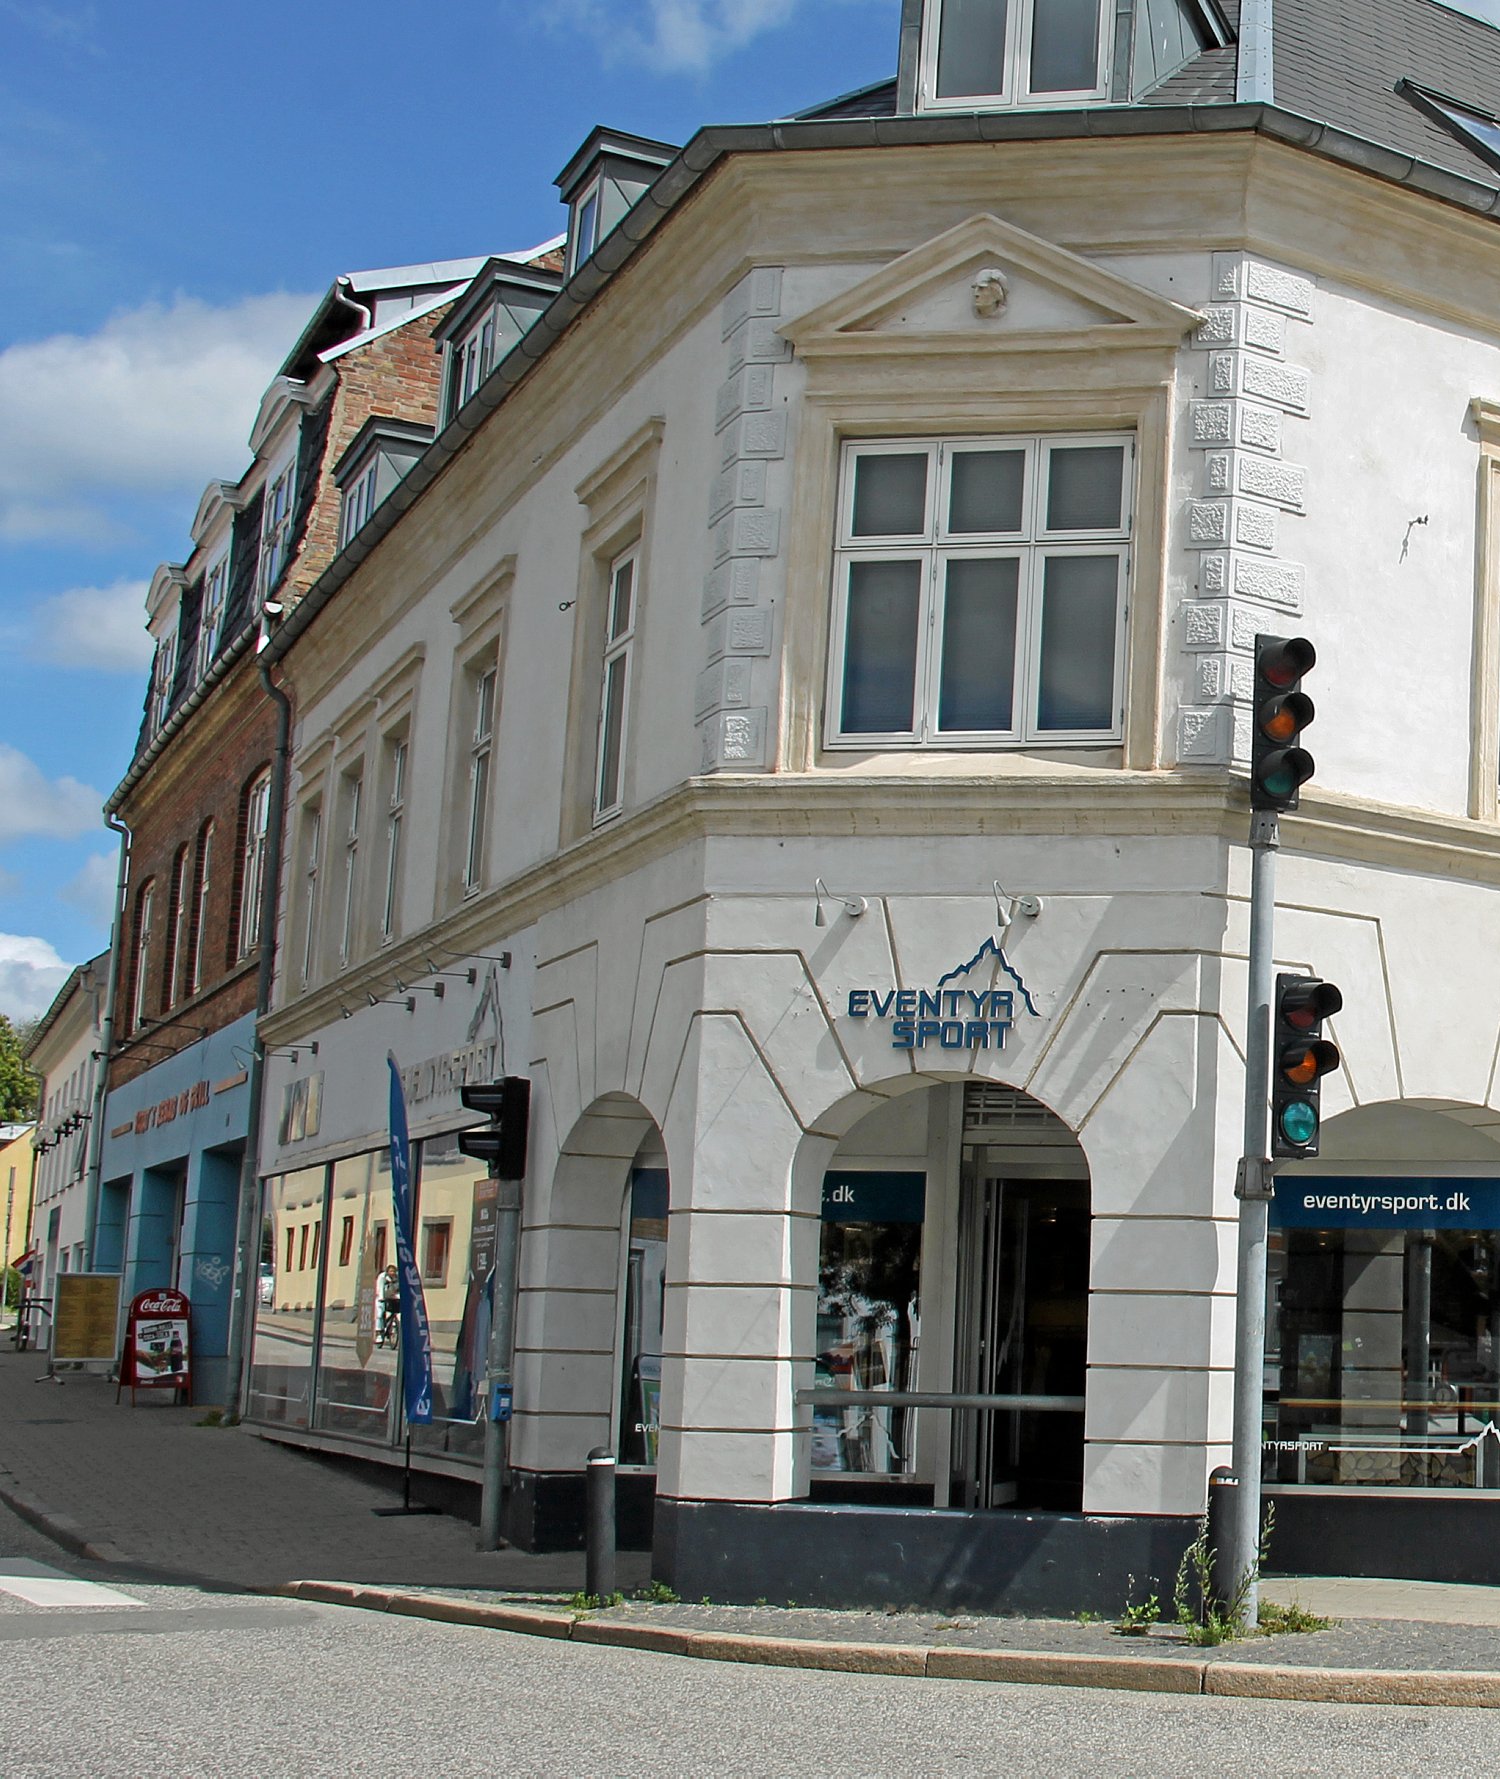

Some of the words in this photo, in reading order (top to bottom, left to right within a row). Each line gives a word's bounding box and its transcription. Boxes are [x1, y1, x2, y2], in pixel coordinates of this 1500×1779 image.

[848, 990, 1014, 1017] EVENTYR
[892, 1021, 1014, 1049] SPORT
[1303, 1192, 1471, 1215] eventyrsport.dk
[1260, 1440, 1324, 1451] NTYRSPORT
